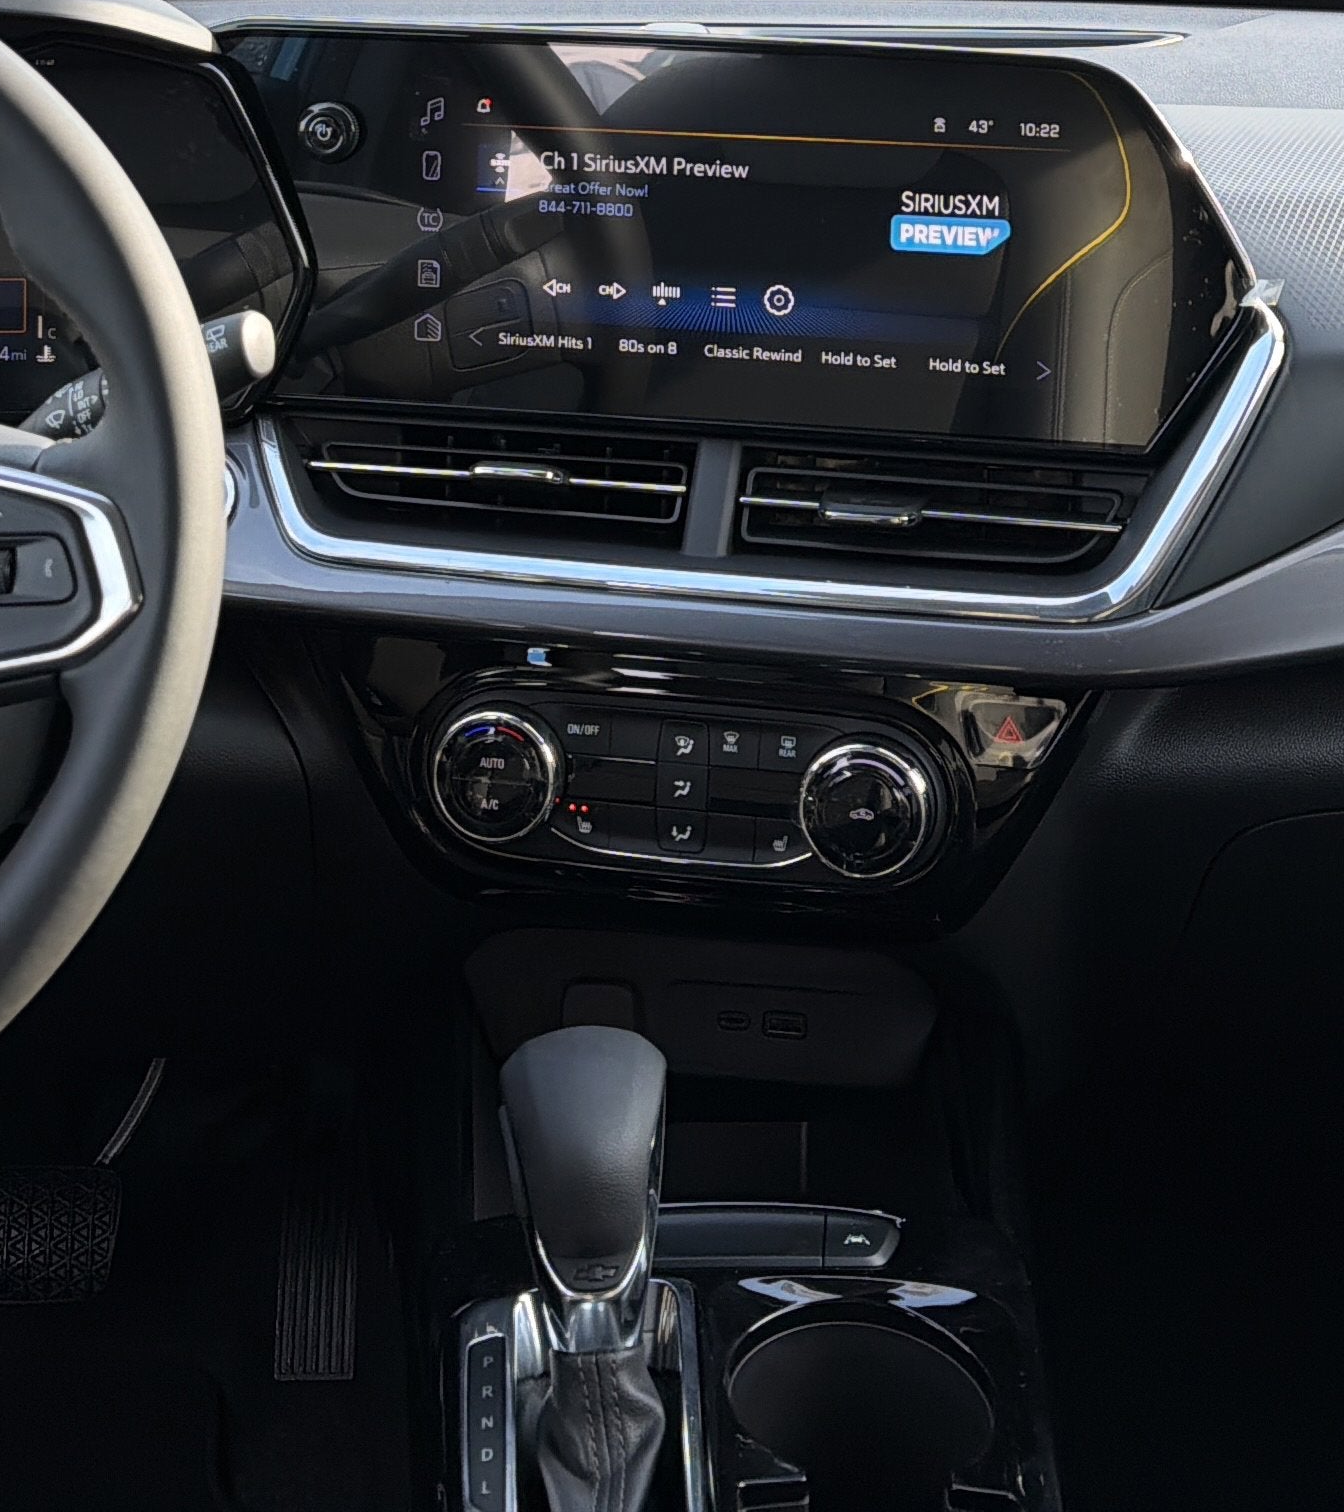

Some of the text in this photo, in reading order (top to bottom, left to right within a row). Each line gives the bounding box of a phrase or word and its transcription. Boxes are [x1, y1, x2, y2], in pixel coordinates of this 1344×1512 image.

[967, 119, 1061, 139] 43° 10:22
[539, 151, 750, 179] Ch 1 SiriusXM Preview
[578, 182, 612, 197] Offer
[615, 183, 649, 199] Now!
[538, 199, 634, 218] 844-711-8800
[900, 190, 1000, 217] SIRIUSXM
[900, 223, 1001, 248] PREVIEW
[206, 337, 229, 353] EAR
[498, 331, 593, 351] SiriusXM Hits 1
[618, 338, 678, 355] 80s on 8
[704, 343, 803, 364] Classic Rewind
[821, 350, 897, 370] Hold to Set
[928, 357, 1006, 376] Hold to Set
[566, 723, 601, 737] ON/OFF
[722, 743, 739, 753] MAX
[778, 748, 797, 758] REAR
[479, 756, 505, 770] AUTO
[480, 798, 500, 811] A/C
[482, 1356, 494, 1369] P
[481, 1384, 494, 1399] R
[481, 1415, 494, 1430] N
[481, 1447, 494, 1462] D
[481, 1480, 492, 1495] L
